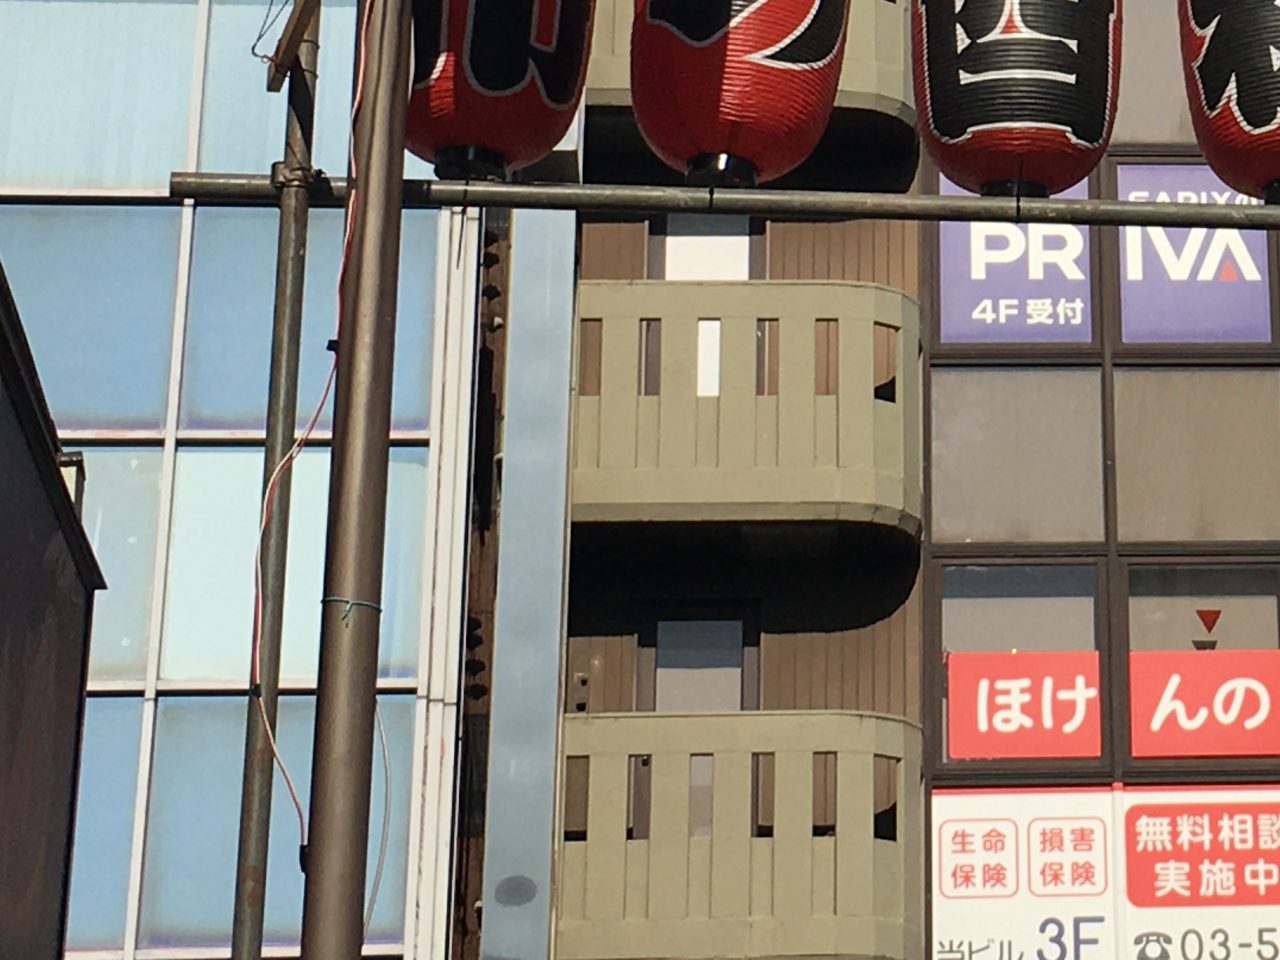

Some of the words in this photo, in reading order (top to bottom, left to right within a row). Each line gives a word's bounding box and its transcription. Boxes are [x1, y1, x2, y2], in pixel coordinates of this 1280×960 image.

[951, 828, 1007, 854] 生命
[1040, 827, 1096, 852] 損害
[951, 863, 1008, 889] 保険
[1040, 861, 1096, 887] 保険
[1154, 858, 1280, 897] 実施中
[1036, 915, 1106, 960] 3F
